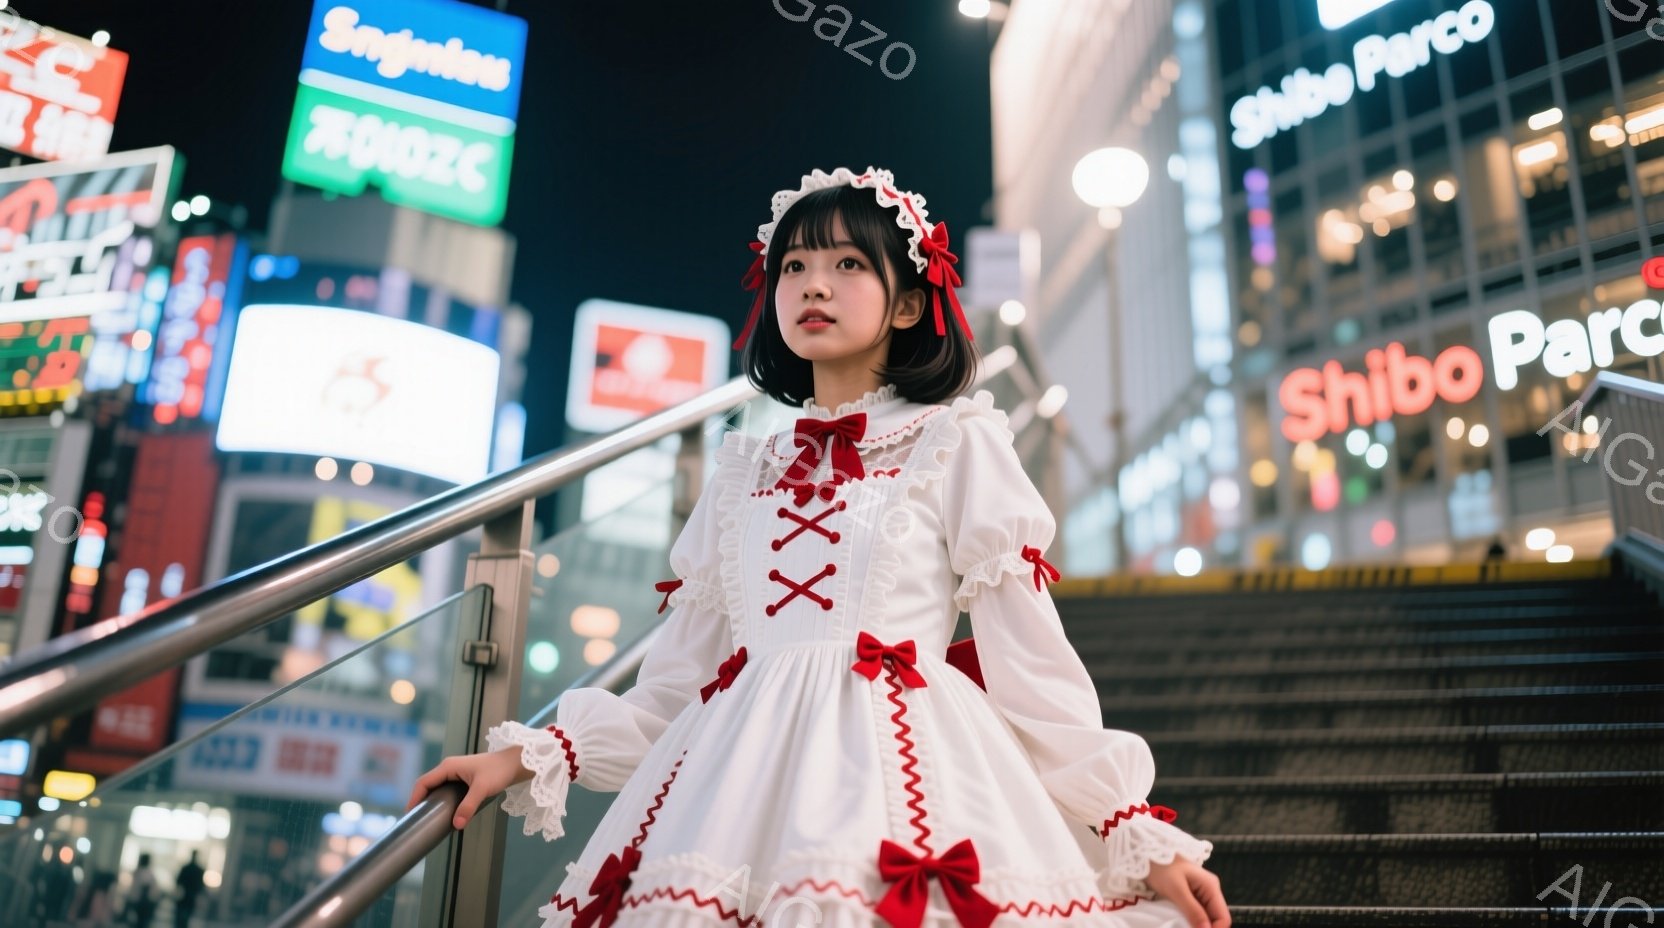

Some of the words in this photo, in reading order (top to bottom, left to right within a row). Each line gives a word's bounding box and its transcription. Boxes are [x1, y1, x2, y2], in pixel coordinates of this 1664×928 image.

[1353, 0, 1494, 92] Parco
[1279, 341, 1484, 443] Shibo
[1488, 299, 1664, 391] Parc
